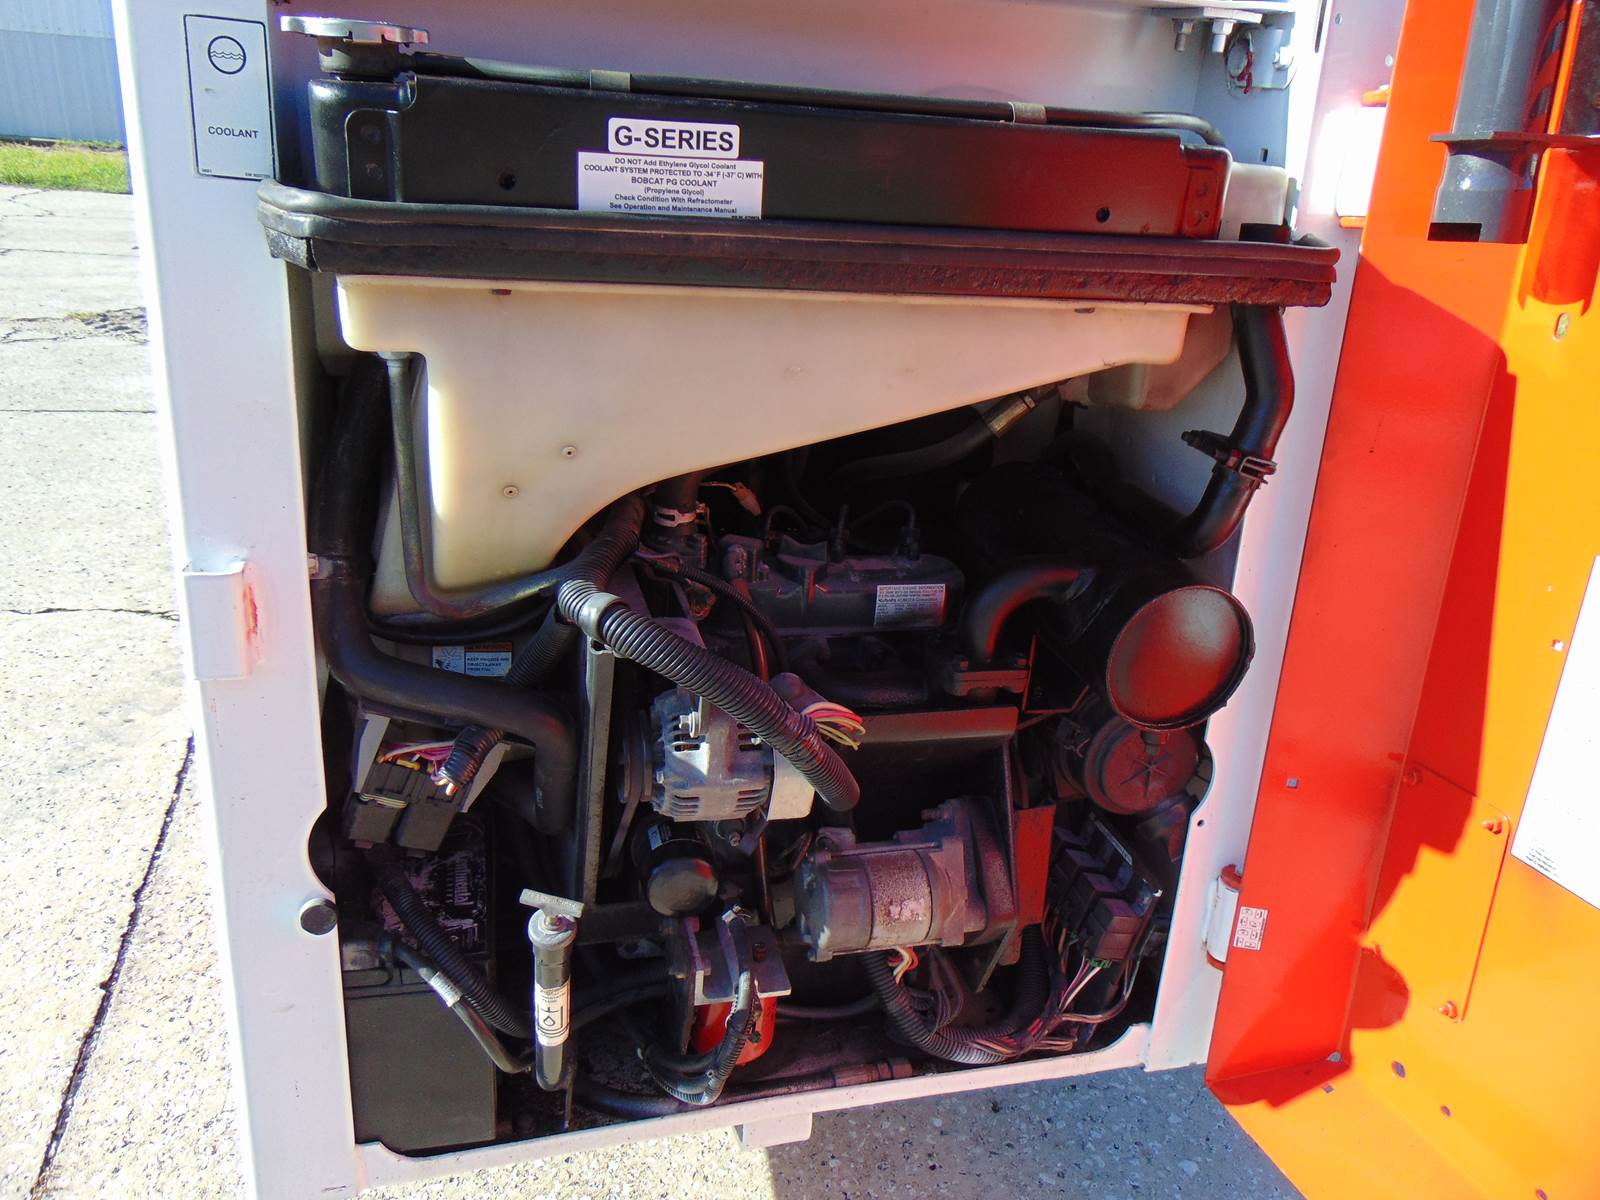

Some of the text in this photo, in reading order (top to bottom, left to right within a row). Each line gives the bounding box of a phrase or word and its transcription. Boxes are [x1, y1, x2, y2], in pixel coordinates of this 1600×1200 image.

[208, 126, 258, 138] COOLANT
[614, 125, 734, 152] G-SERIES
[659, 160, 687, 168] Ethylene
[689, 161, 709, 169] Glycol
[711, 162, 736, 170] Coolant
[584, 165, 618, 173] COOLANT
[650, 168, 692, 177] PROTECTED
[631, 176, 717, 187] BOBCAT PG COOLANT
[681, 189, 704, 197] Glycol)
[624, 203, 656, 211] Operation
